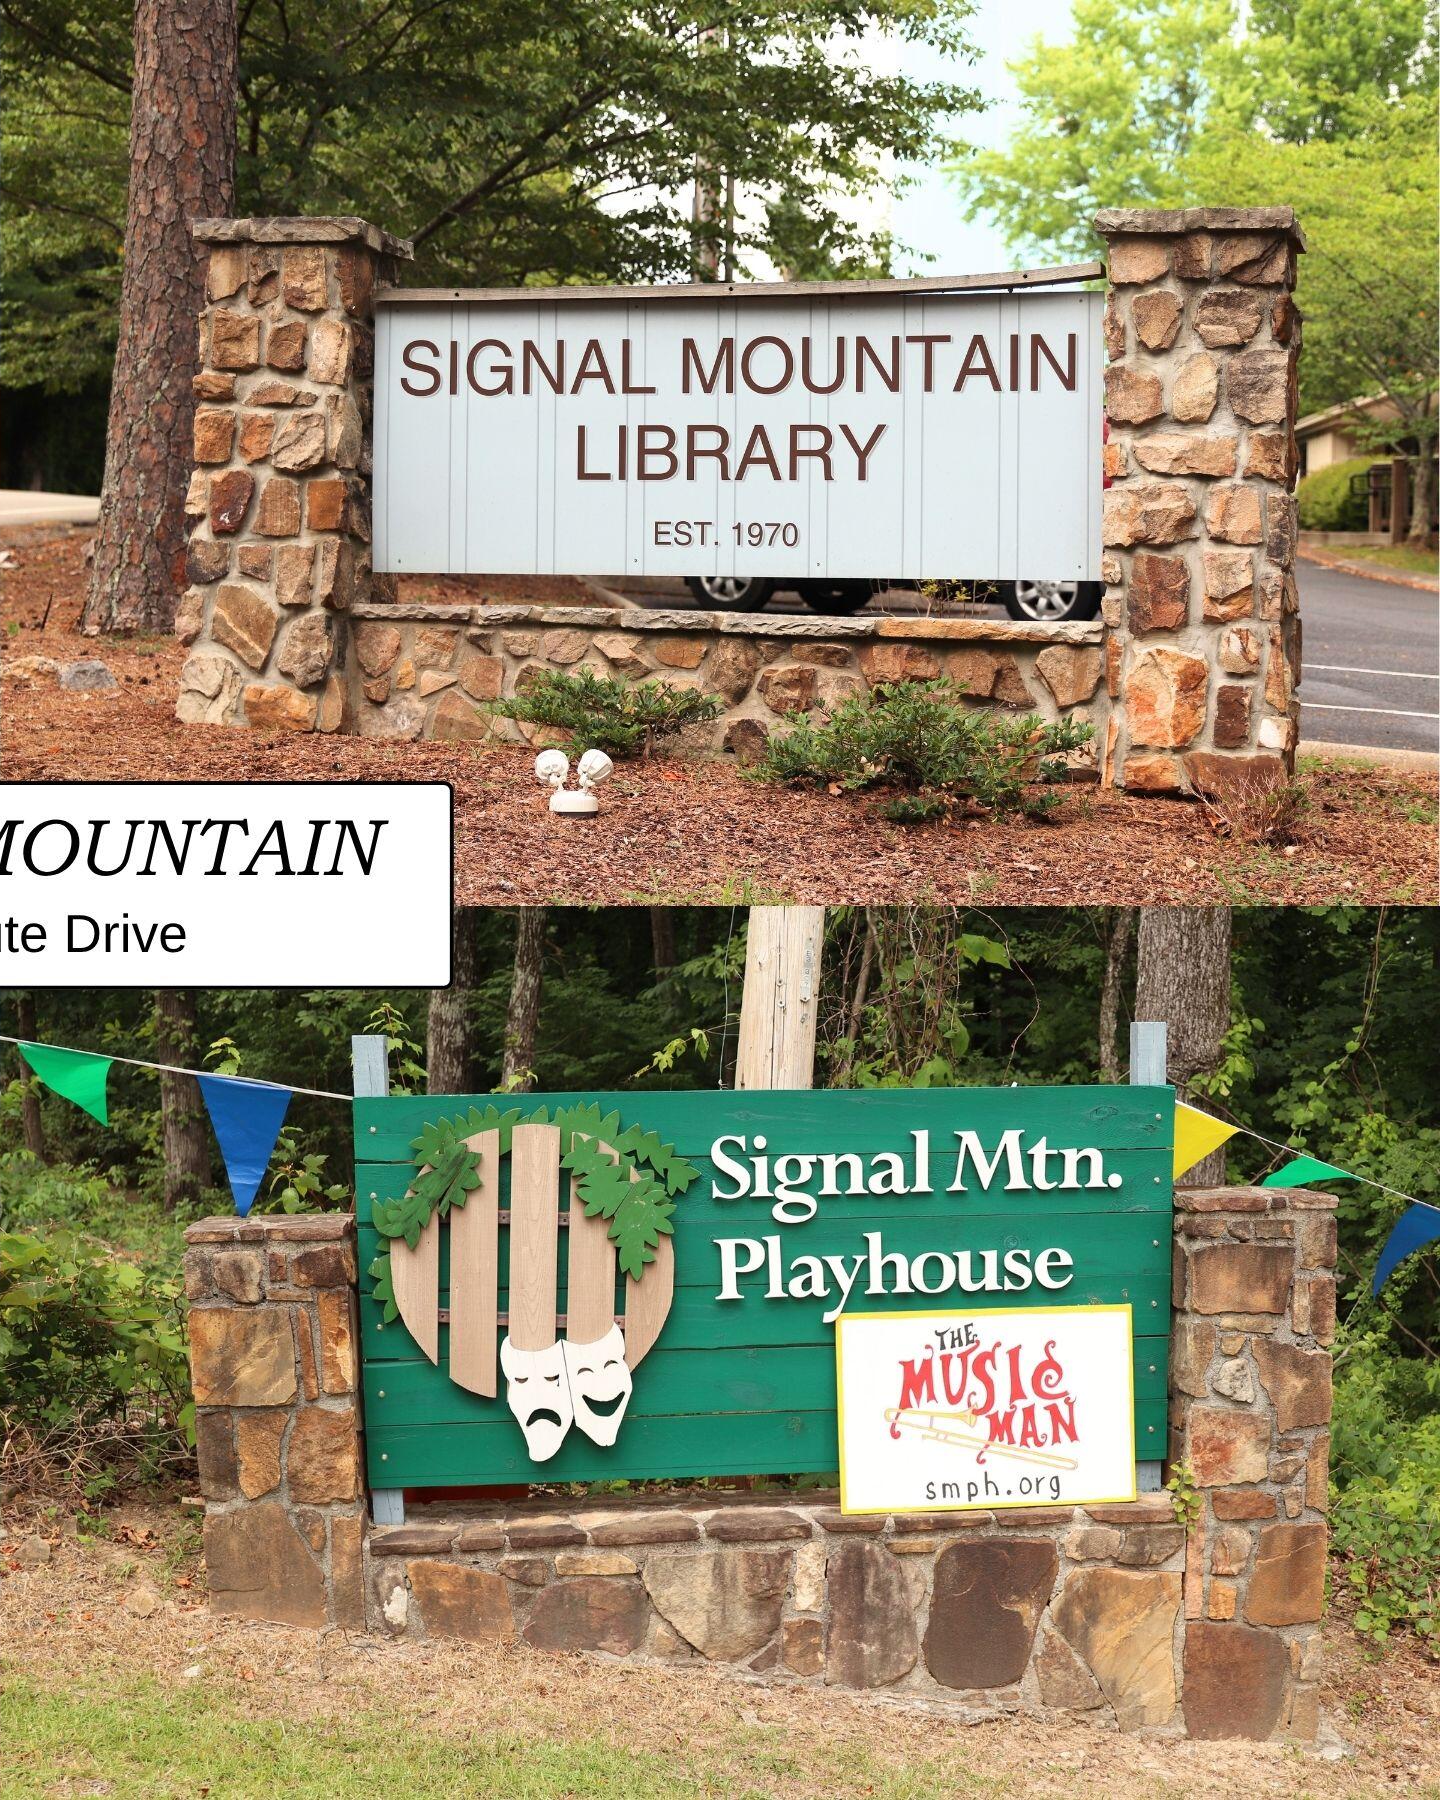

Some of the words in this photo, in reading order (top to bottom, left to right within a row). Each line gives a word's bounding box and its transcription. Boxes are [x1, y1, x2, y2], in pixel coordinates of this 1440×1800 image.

[400, 338, 657, 397] SIGNAL
[681, 333, 1078, 395] MOUNTAIN
[576, 423, 888, 482] LIBRARY
[654, 521, 720, 547] EST.
[732, 522, 800, 548] 1970
[710, 1129, 934, 1224] Signal
[946, 1129, 1123, 1192] Mtn.
[713, 1231, 1074, 1324] Playhouse
[934, 1322, 978, 1352] THE
[890, 1339, 1071, 1440] MUSIC
[976, 1396, 1080, 1465] MAN
[926, 1472, 1061, 1502] smph.org
